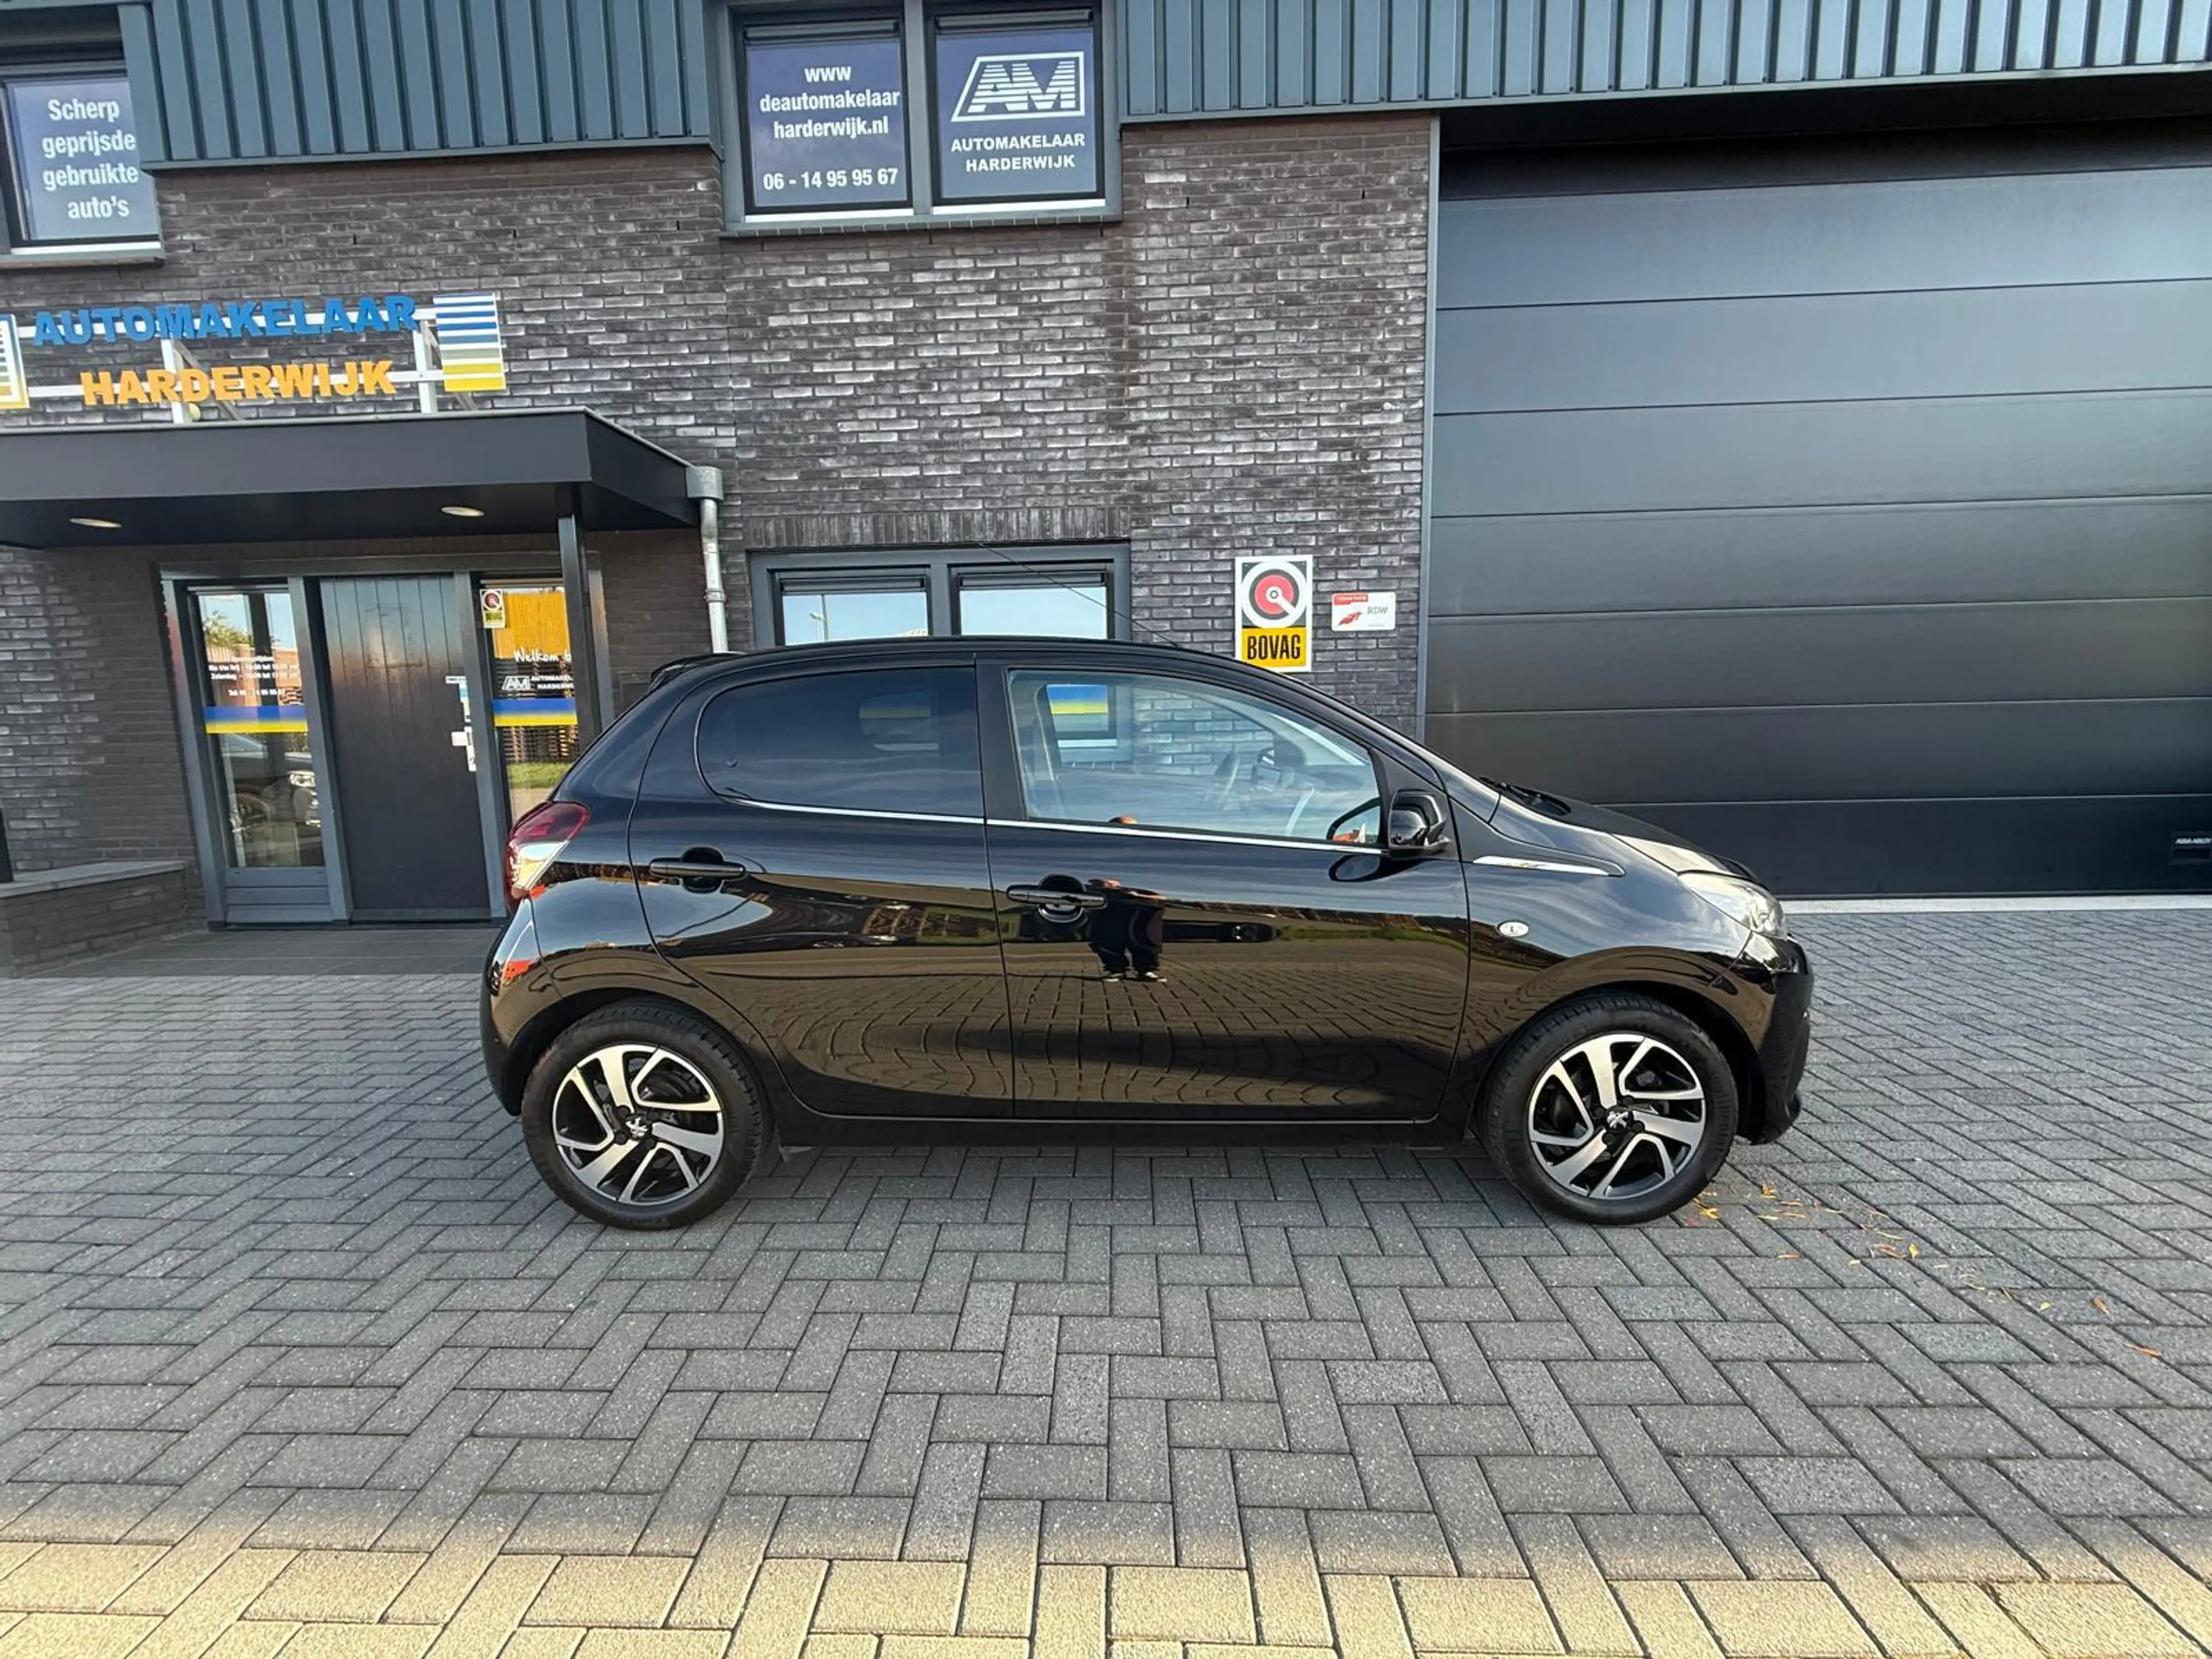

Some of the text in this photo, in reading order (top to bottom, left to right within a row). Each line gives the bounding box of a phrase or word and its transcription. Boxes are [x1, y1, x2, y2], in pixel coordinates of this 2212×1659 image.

[804, 66, 851, 82] www
[48, 98, 120, 122] Scherp
[760, 89, 900, 113] deautomakelaar
[774, 115, 889, 139] harderwijk.nl
[42, 130, 136, 158] geprijsde
[951, 133, 1085, 152] AUTOMAKELAAR
[966, 154, 1075, 172] HARDERWIJK
[43, 163, 139, 191] gebruikte
[763, 173, 785, 190] 06
[801, 171, 822, 189] 14
[826, 171, 847, 187] 95
[851, 169, 873, 186] 95
[877, 168, 898, 184] 67
[67, 195, 130, 219] auto's
[33, 296, 420, 346] AUTOMAKELAAR
[80, 360, 397, 406] HARDERWIJK
[513, 646, 559, 662] Welkom
[1247, 634, 1300, 660] BOVAG
